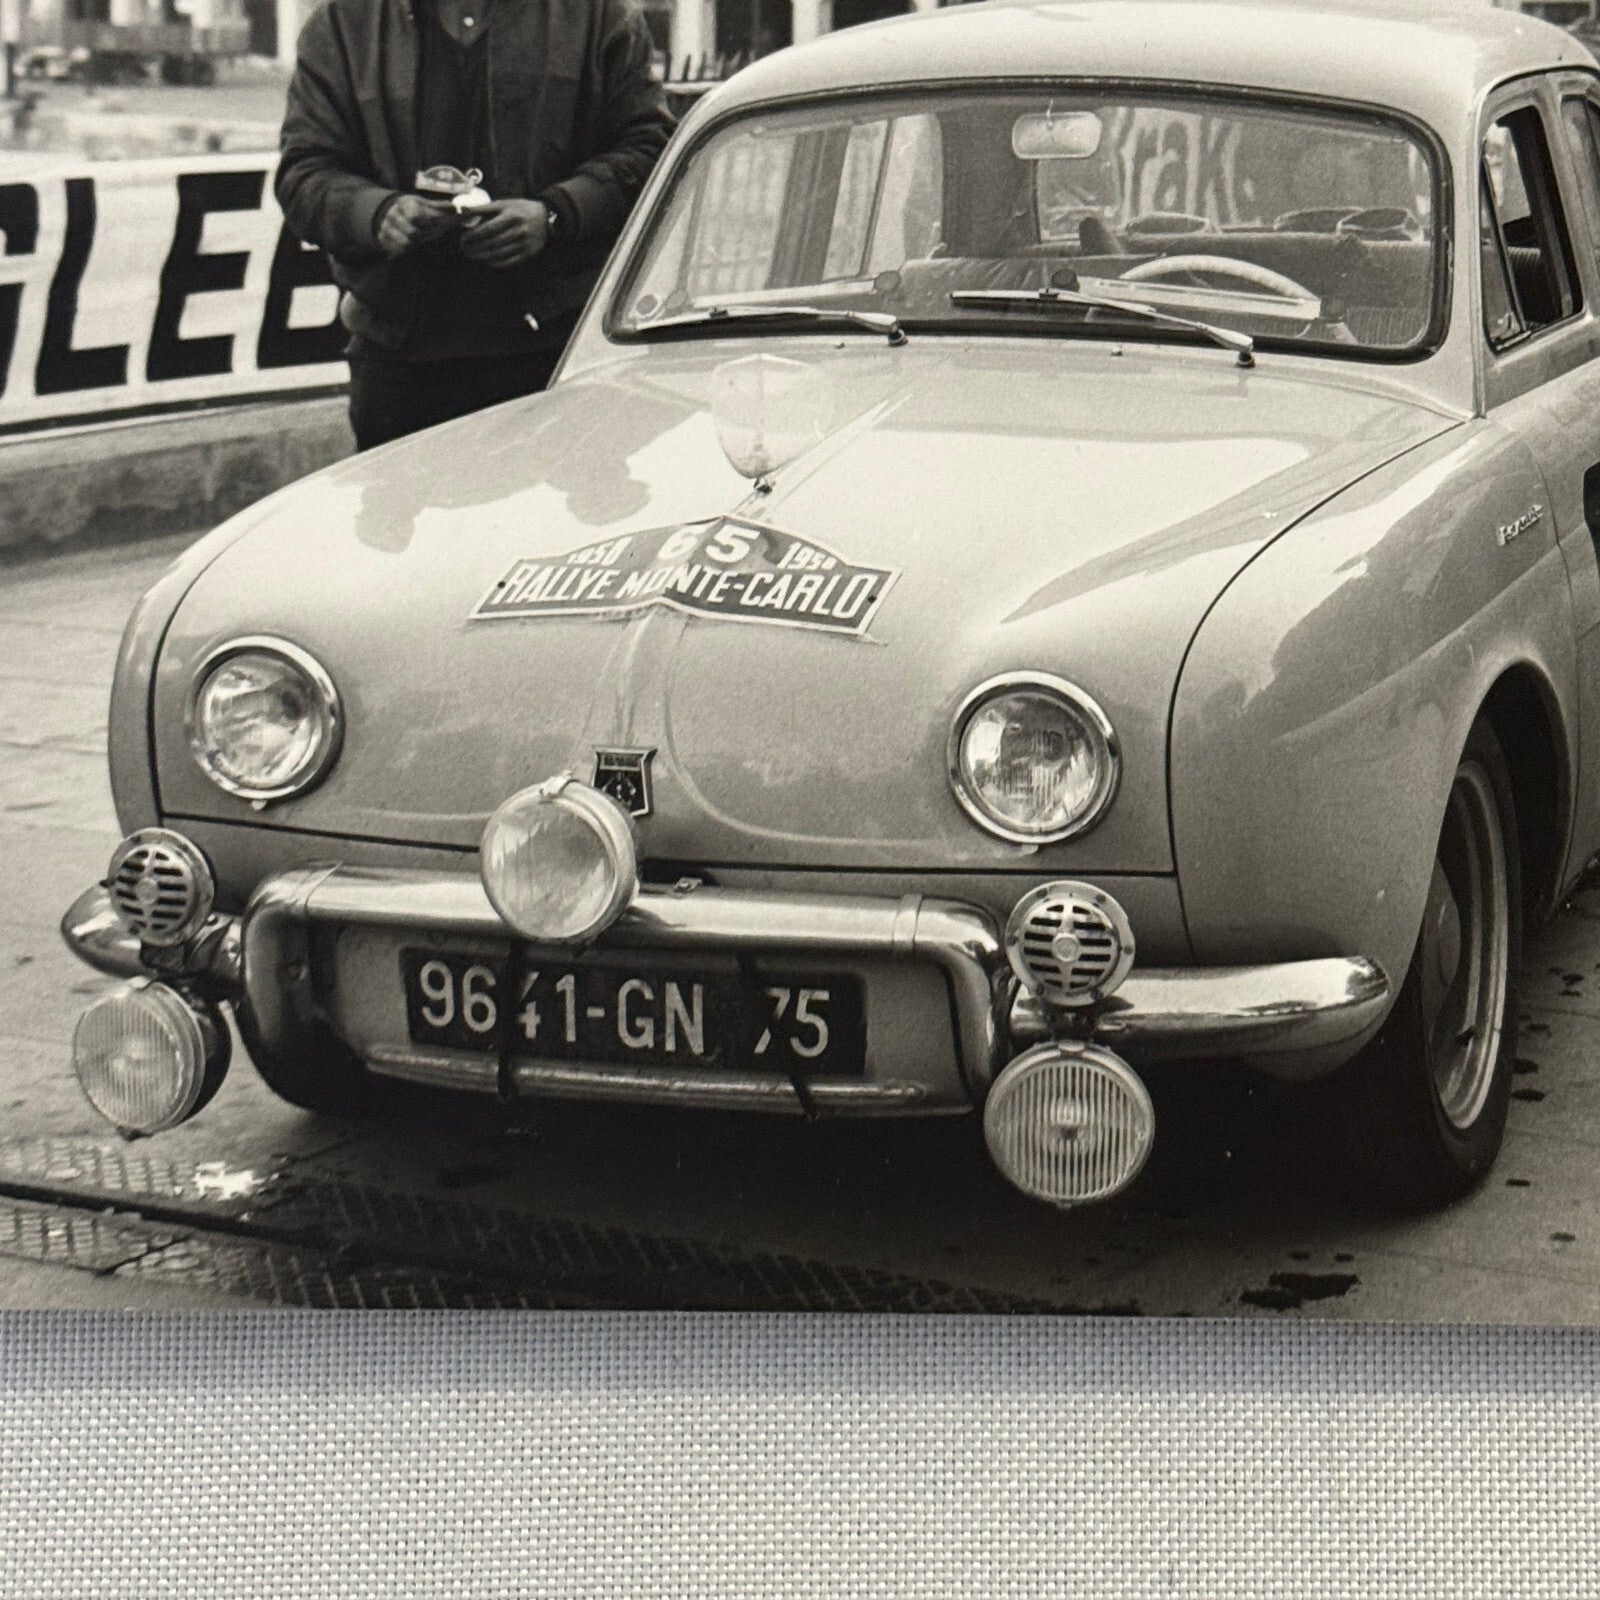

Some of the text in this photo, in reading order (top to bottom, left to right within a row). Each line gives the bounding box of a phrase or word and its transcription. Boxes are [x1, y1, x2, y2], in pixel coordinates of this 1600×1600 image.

[658, 522, 761, 563] 65
[489, 563, 879, 620] RALLYE MONTE-CARLO
[753, 986, 831, 1059] 75
